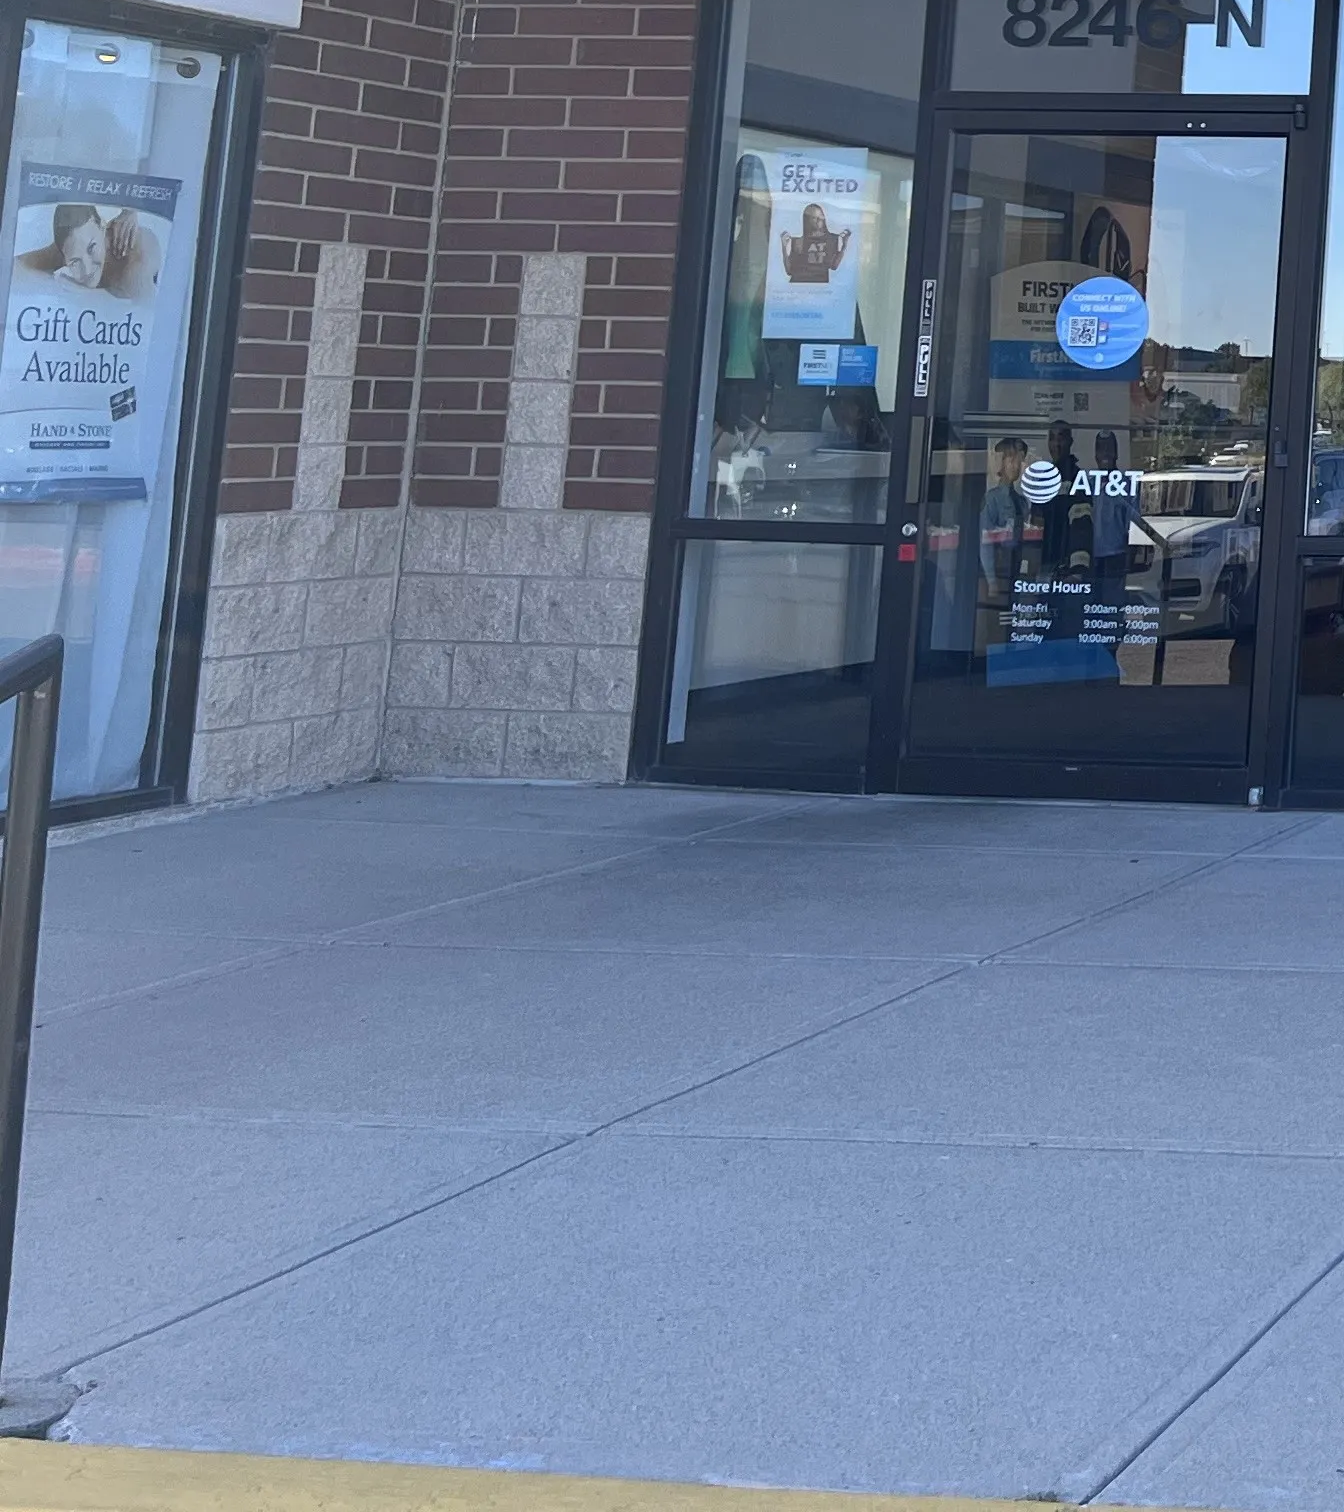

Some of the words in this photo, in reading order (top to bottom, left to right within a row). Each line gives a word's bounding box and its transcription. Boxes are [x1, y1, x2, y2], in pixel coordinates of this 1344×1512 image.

[782, 164, 818, 179] GET
[28, 172, 74, 191] RESTORE
[86, 179, 122, 196] RELAX
[781, 179, 859, 193] EXCITED
[1022, 281, 1074, 298] FIRST
[924, 280, 933, 317] PULL
[17, 306, 71, 343] Gift
[77, 309, 143, 347] Cards
[21, 350, 130, 384] Available
[918, 345, 930, 384] PULL
[30, 423, 67, 437] HAND
[78, 423, 113, 437] STONE
[1069, 470, 1145, 497] AT&T
[1014, 580, 1050, 594] Store
[1052, 580, 1092, 594] Hours
[1012, 603, 1048, 613] Mon-Fri
[1083, 604, 1118, 614] 9:00am
[1124, 604, 1160, 616] 8:00pm
[1011, 616, 1052, 630] Saturday
[1083, 619, 1118, 629] 9:00am
[1125, 620, 1159, 631] 7:00pm
[1010, 632, 1044, 644] Sunday
[1078, 633, 1116, 643] 10:00am
[1123, 634, 1158, 645] 6:00pm
